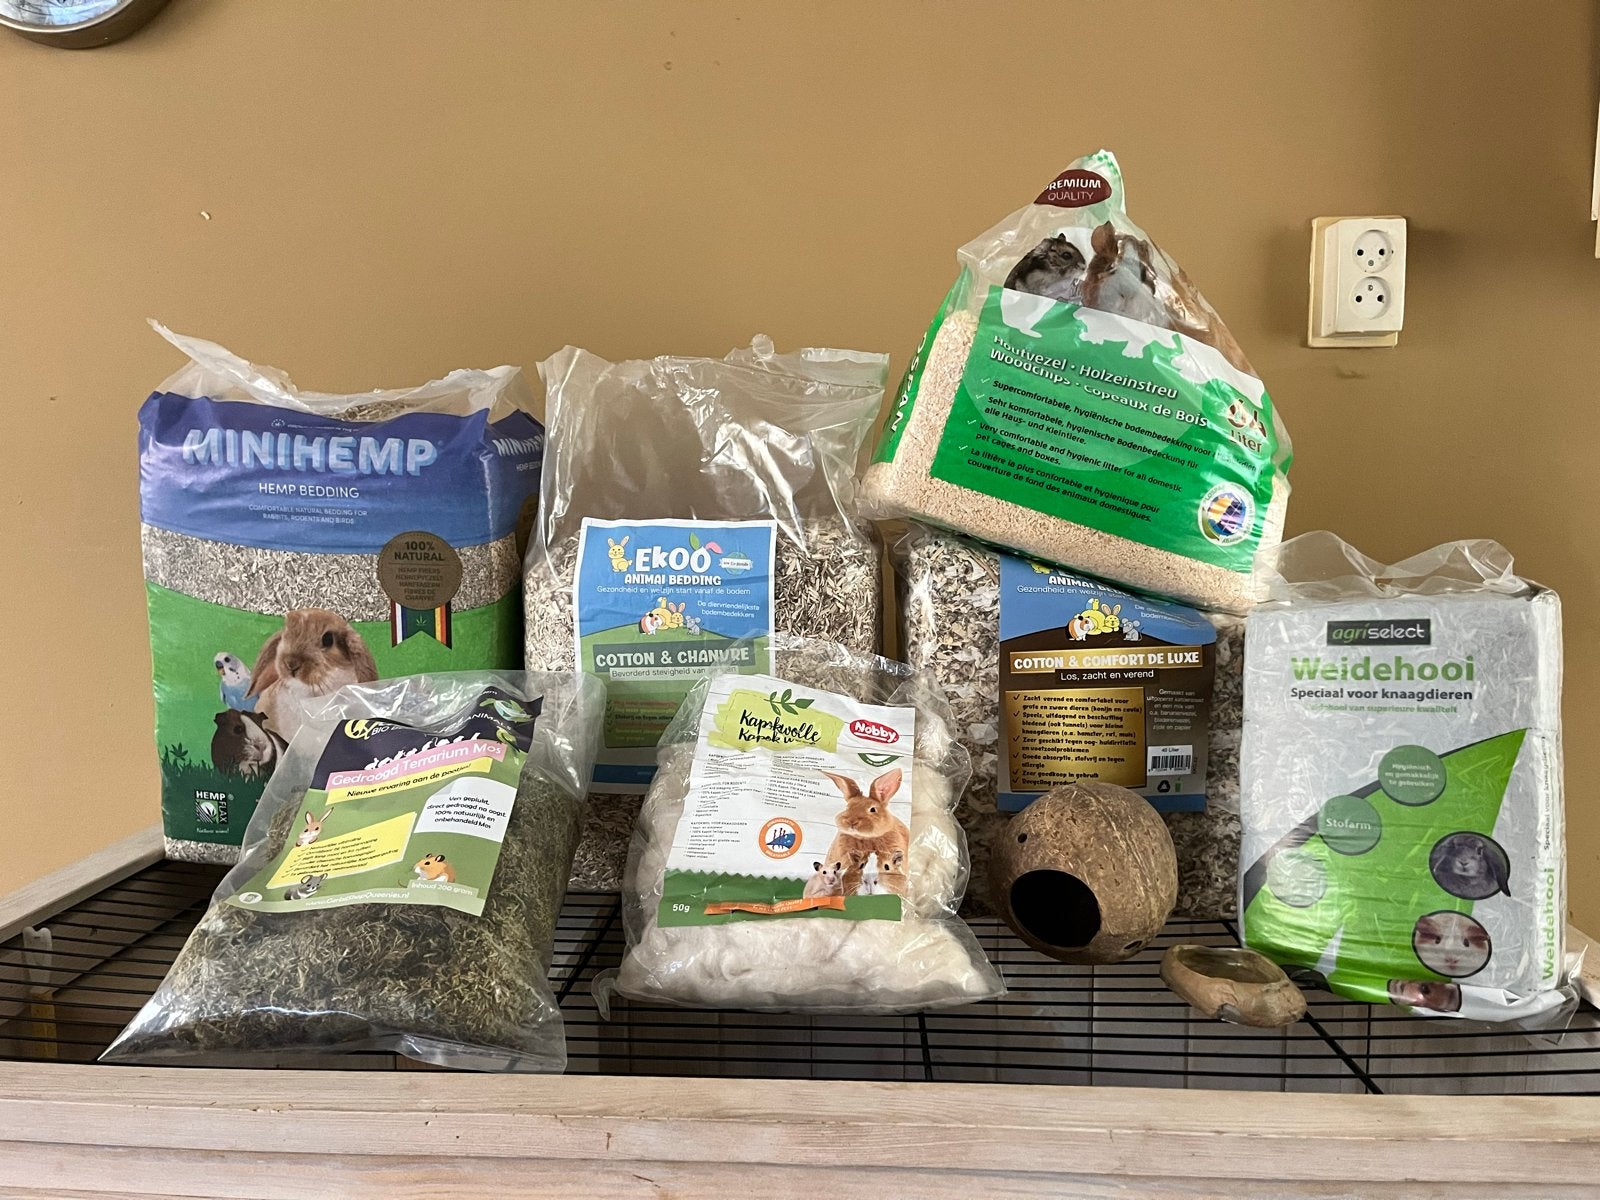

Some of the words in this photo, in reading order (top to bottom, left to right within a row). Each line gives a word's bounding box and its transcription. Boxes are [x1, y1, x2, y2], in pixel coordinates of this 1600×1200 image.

[1048, 192, 1094, 200] QUALITY
[994, 335, 1066, 370] Houtvezel
[1080, 365, 1177, 399] Holzeinstreu
[990, 349, 1070, 385] Woodchips
[1153, 404, 1171, 417] de
[1176, 410, 1208, 427] Bois
[985, 407, 1000, 416] alle
[1002, 412, 1025, 423] Haus-
[1028, 421, 1043, 431] und
[1046, 426, 1086, 445] Kleintiere.
[993, 381, 1071, 411] Supercomfortabele,
[1074, 406, 1123, 427] hygiënische
[1125, 423, 1192, 451] bodembedekking
[1194, 446, 1211, 455] voor
[1008, 403, 1064, 426] komfortabele,
[1117, 438, 1185, 465] Bodenbedeckung
[1231, 430, 1261, 452] Liter
[182, 428, 437, 477] MINIHEMP
[976, 433, 990, 442] pet
[992, 438, 1015, 449] cages
[1017, 447, 1033, 455] and
[1035, 451, 1061, 465] boxes.
[1000, 430, 1047, 449] comfortable
[1049, 445, 1065, 454] and
[1066, 449, 1101, 467] hygienic
[1102, 462, 1122, 473] litter
[1124, 469, 1134, 477] for
[1136, 473, 1146, 481] all
[1148, 477, 1182, 492] domestic
[968, 459, 1011, 477] couverture
[1013, 472, 1023, 480] de
[1025, 477, 1044, 487] fond
[1046, 484, 1059, 493] des
[1062, 489, 1098, 505] animaux
[1017, 462, 1034, 473] plus
[1036, 469, 1082, 488] confortable
[1141, 503, 1159, 513] pour
[259, 483, 296, 496] HEMP
[300, 485, 359, 498] BEDDING
[249, 504, 294, 513] COMFORTABLE
[405, 541, 434, 550] 100%
[394, 552, 444, 561] NATURAL
[669, 574, 721, 586] BEDDING
[651, 587, 673, 595] welzijn
[1017, 585, 1064, 594] Gezondheid
[702, 610, 754, 618] bodembedekkers
[708, 601, 759, 611] diervriendelijkste
[1332, 623, 1425, 643] agriselect
[596, 652, 655, 667] COTTON
[661, 651, 672, 664] &
[677, 647, 749, 663] CHANVRE
[1014, 657, 1064, 669] COTTON
[1069, 656, 1078, 666] &
[1083, 654, 1145, 668] COMFORT
[1147, 653, 1164, 665] DE
[1168, 652, 1199, 664] LUXE
[612, 669, 650, 678] Bevorderd
[652, 668, 690, 677] stevigheid
[1061, 672, 1080, 681] Los,
[1083, 671, 1107, 680] zacht
[1124, 670, 1154, 678] verend
[1291, 655, 1474, 681] Weidehooi
[1291, 688, 1343, 699] Speciaal
[1347, 689, 1378, 698] voor
[1382, 689, 1472, 701] knaagdieren
[372, 726, 388, 735] BIO
[855, 722, 896, 742] Nobby
[332, 764, 398, 785] Gedroogd
[403, 747, 469, 772] Terrarium
[472, 743, 501, 755] Mos
[347, 785, 377, 798] Nieuwe
[379, 779, 411, 792] ervaring
[413, 776, 428, 785] aan
[430, 771, 440, 780] de
[196, 791, 225, 800] HEMP
[219, 801, 227, 822] FLAX
[446, 802, 477, 811] gedroogd
[434, 816, 476, 827] onbehandeld
[478, 821, 492, 829] Mos
[453, 810, 484, 820] natuurlijk
[1326, 818, 1371, 830] Stofarm
[411, 882, 436, 890] Inhoud
[453, 886, 473, 897] gram
[673, 904, 690, 913] 50g
[1542, 867, 1555, 980] Weidehooi
